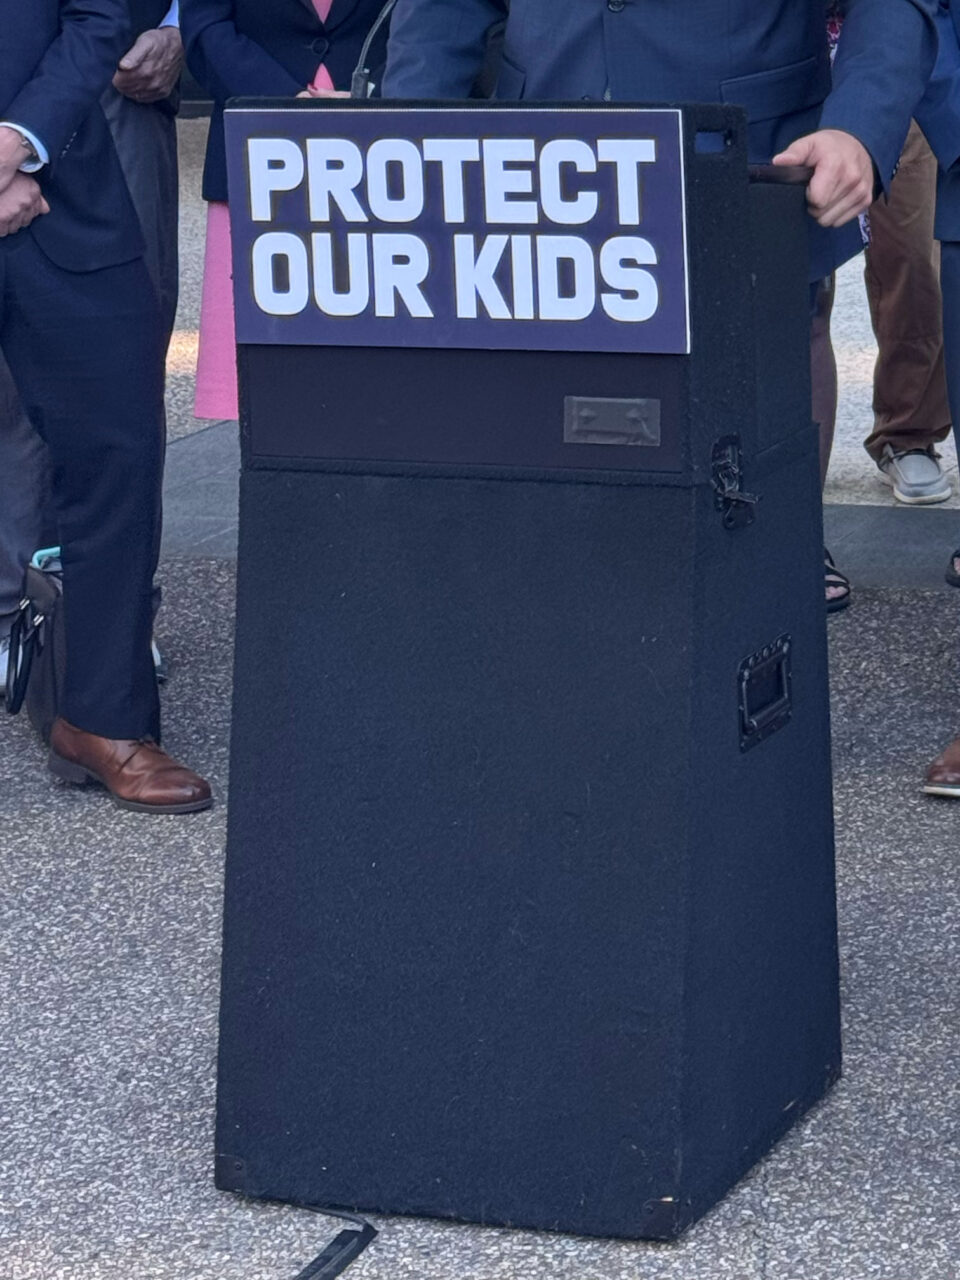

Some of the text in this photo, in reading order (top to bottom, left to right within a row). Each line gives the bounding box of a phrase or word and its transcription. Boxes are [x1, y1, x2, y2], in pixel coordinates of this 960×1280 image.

[247, 138, 656, 225] PROTECT
[252, 232, 658, 322] OUR KIDS
